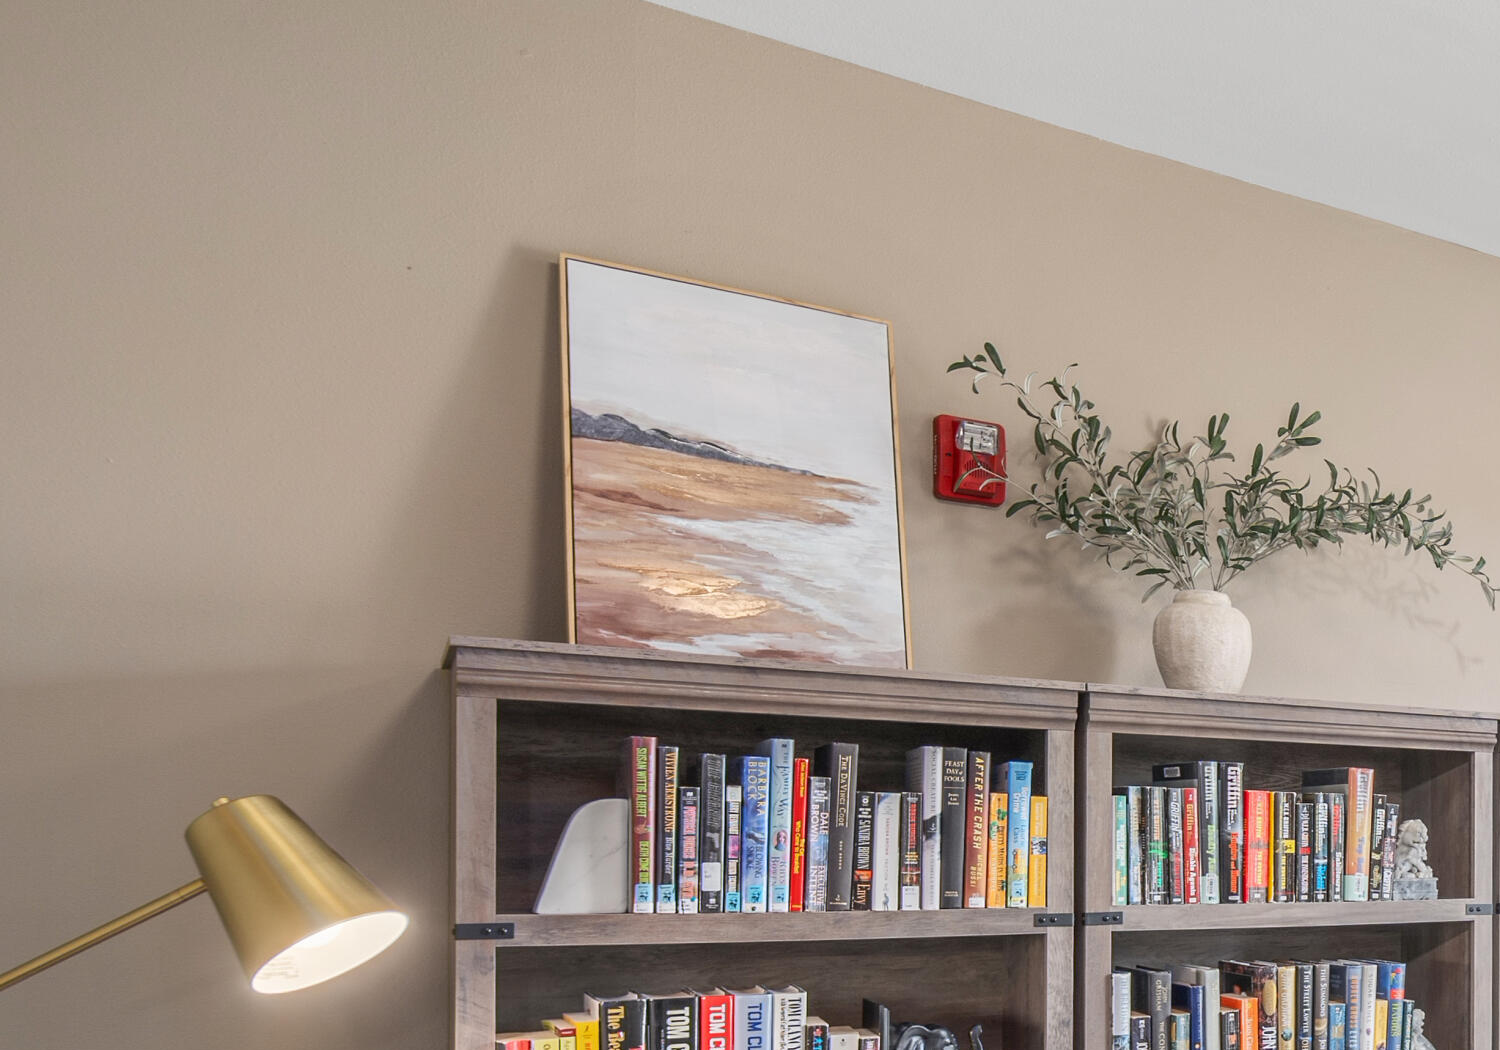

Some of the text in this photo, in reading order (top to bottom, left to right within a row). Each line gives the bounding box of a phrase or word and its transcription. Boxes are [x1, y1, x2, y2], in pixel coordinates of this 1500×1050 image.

[748, 761, 756, 800] BLOCK
[757, 761, 767, 816] BARBARA
[1205, 766, 1214, 801] Griffin
[1227, 766, 1240, 809] Griffin
[973, 757, 984, 849] AFTER THE CRASH
[1171, 802, 1180, 831] GRIFFIN
[811, 805, 819, 842] BROWN
[820, 812, 829, 834] DALE
[857, 820, 871, 869] SANDRA BROWN
[856, 884, 869, 905] Envy
[607, 1006, 624, 1030] The
[666, 1006, 690, 1039] TOM
[709, 1004, 725, 1034] TOM
[747, 1003, 762, 1031] TOM
[787, 998, 801, 1017] TOM
[787, 1018, 801, 1050] CLANCY
[1262, 1026, 1277, 1050] JOHN
